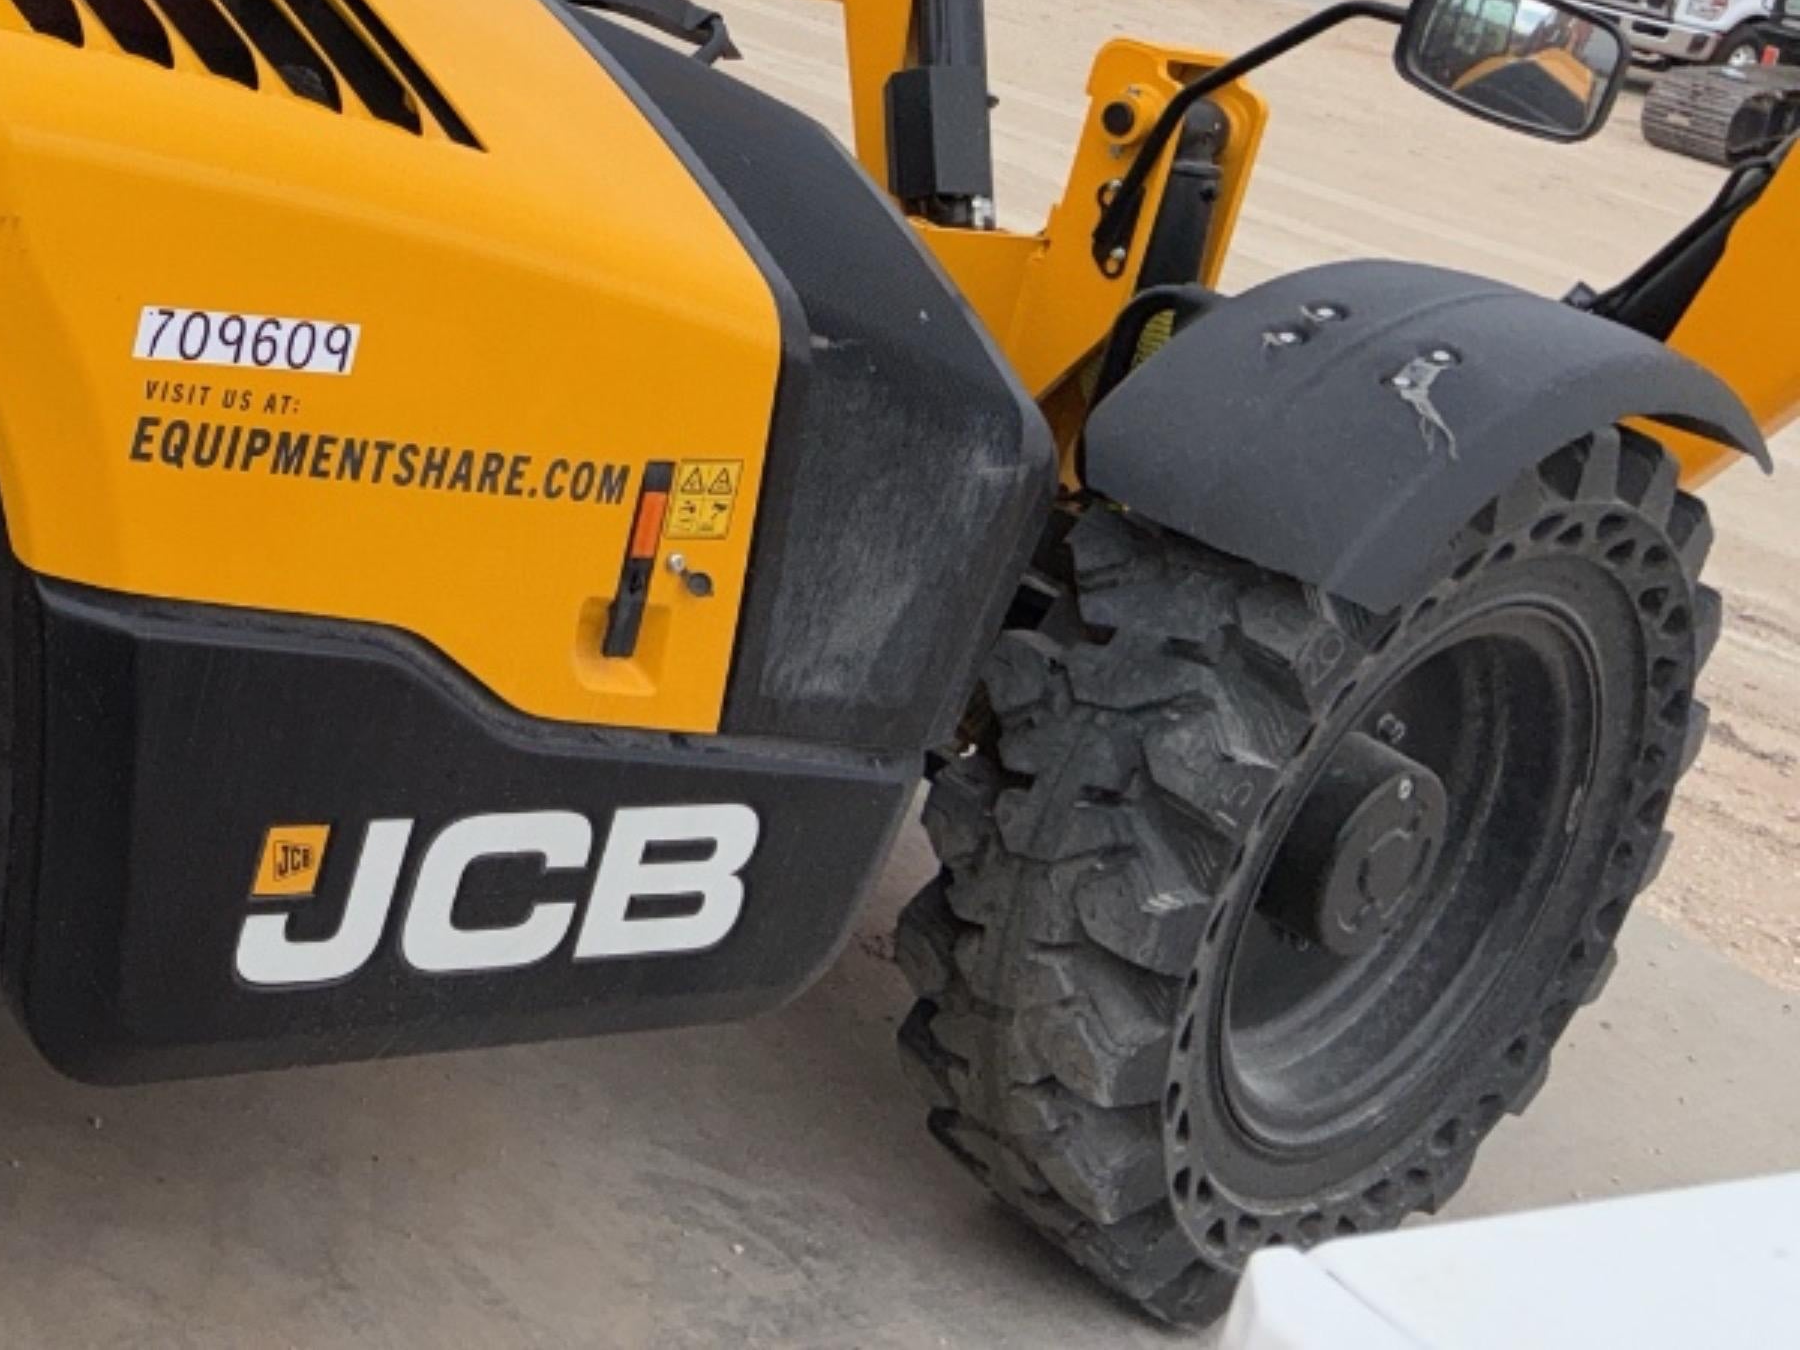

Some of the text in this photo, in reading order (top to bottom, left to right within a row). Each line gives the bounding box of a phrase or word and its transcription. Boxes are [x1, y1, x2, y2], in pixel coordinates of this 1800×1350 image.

[147, 308, 353, 372] 709609
[145, 380, 301, 415] VISIT US AT:
[129, 415, 632, 505] EQUIPMENTSHARE.COM
[277, 844, 310, 877] JCB
[236, 803, 760, 986] JCB
